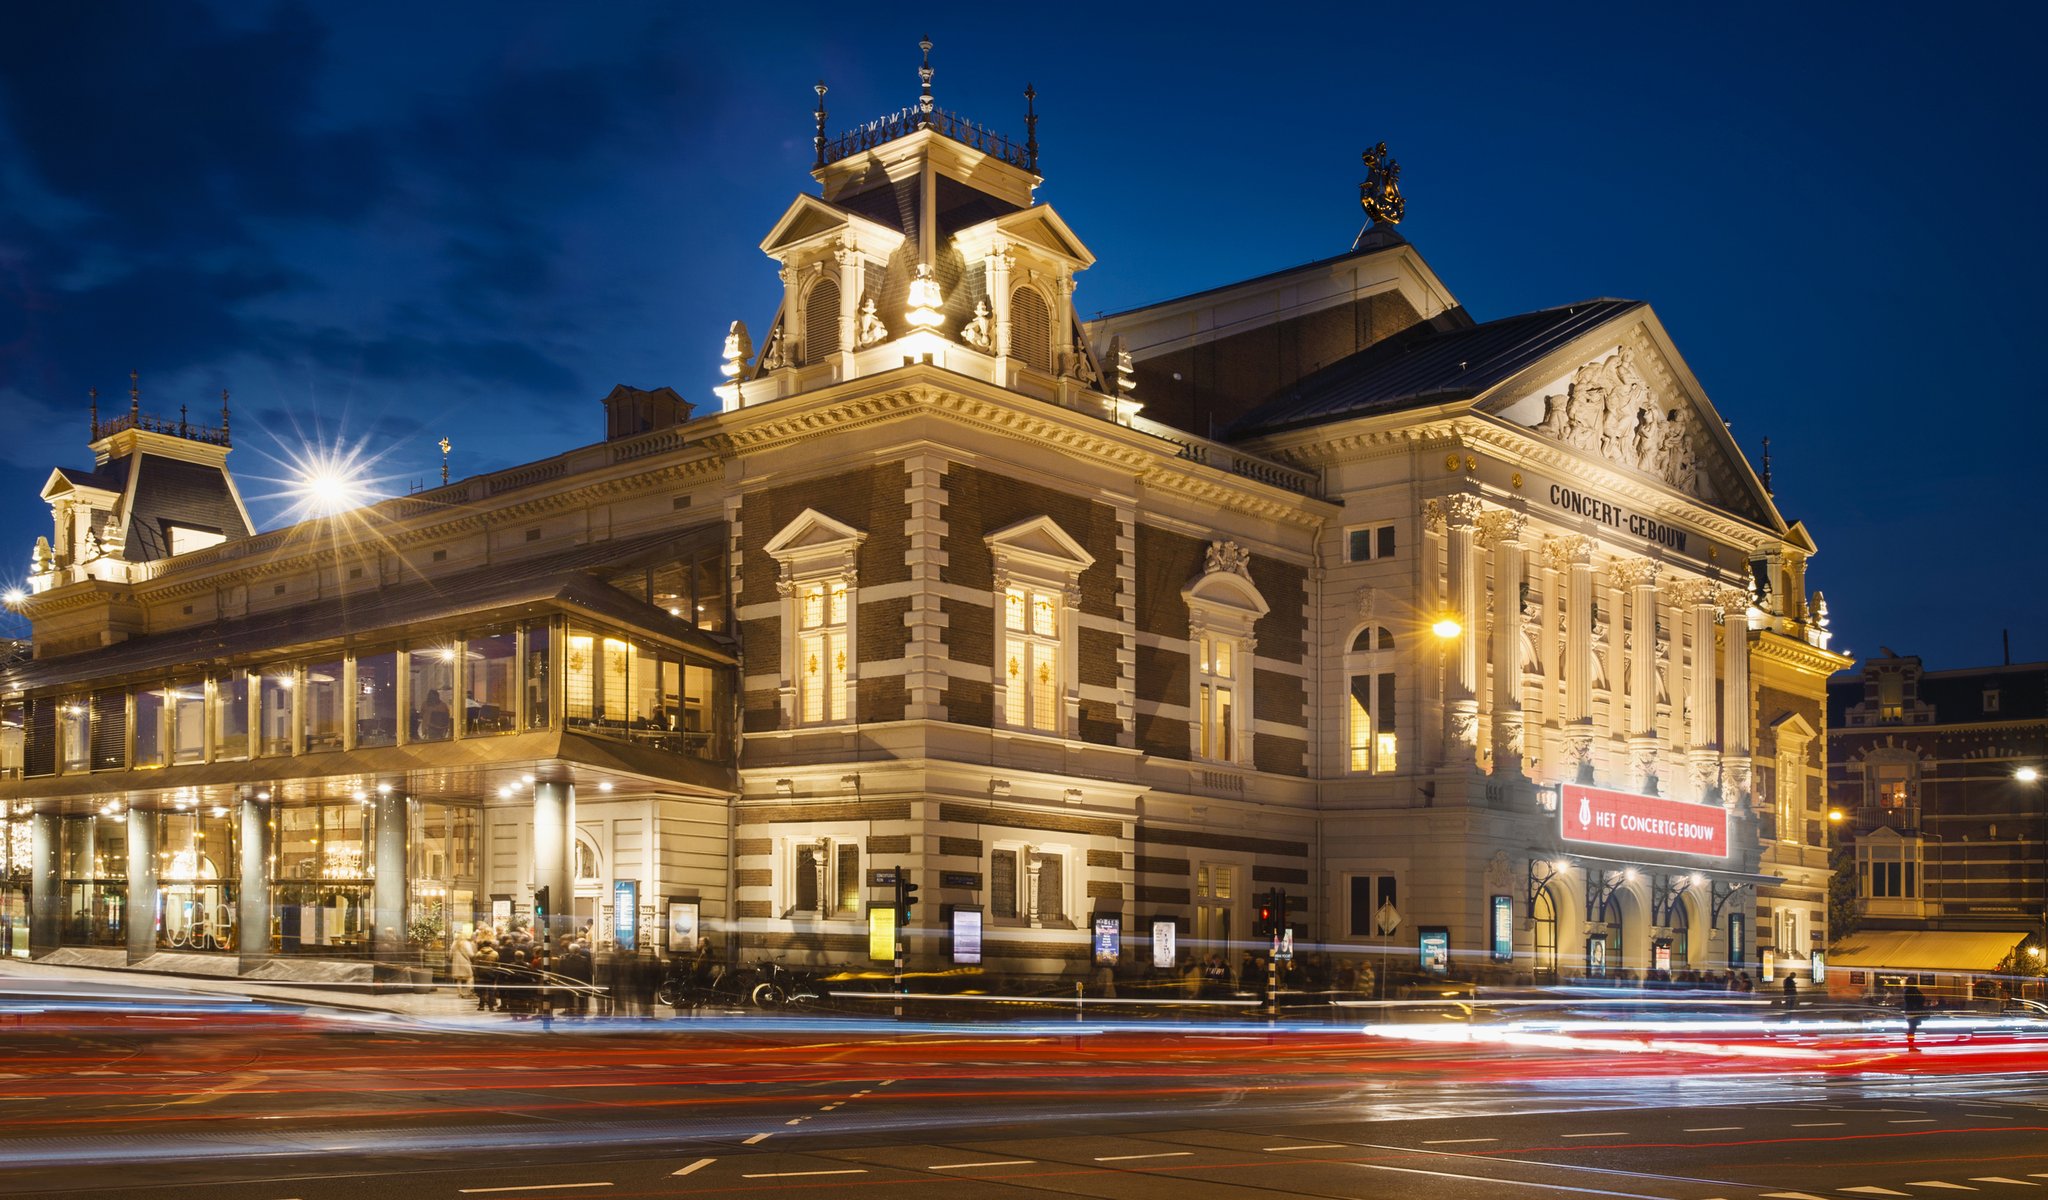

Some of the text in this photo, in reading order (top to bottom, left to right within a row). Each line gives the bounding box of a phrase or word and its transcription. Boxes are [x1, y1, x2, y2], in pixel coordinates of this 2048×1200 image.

[1550, 484, 1687, 552] CONCERT-GEBOUW
[1596, 811, 1714, 840] HET CONCERTGEBOUW
